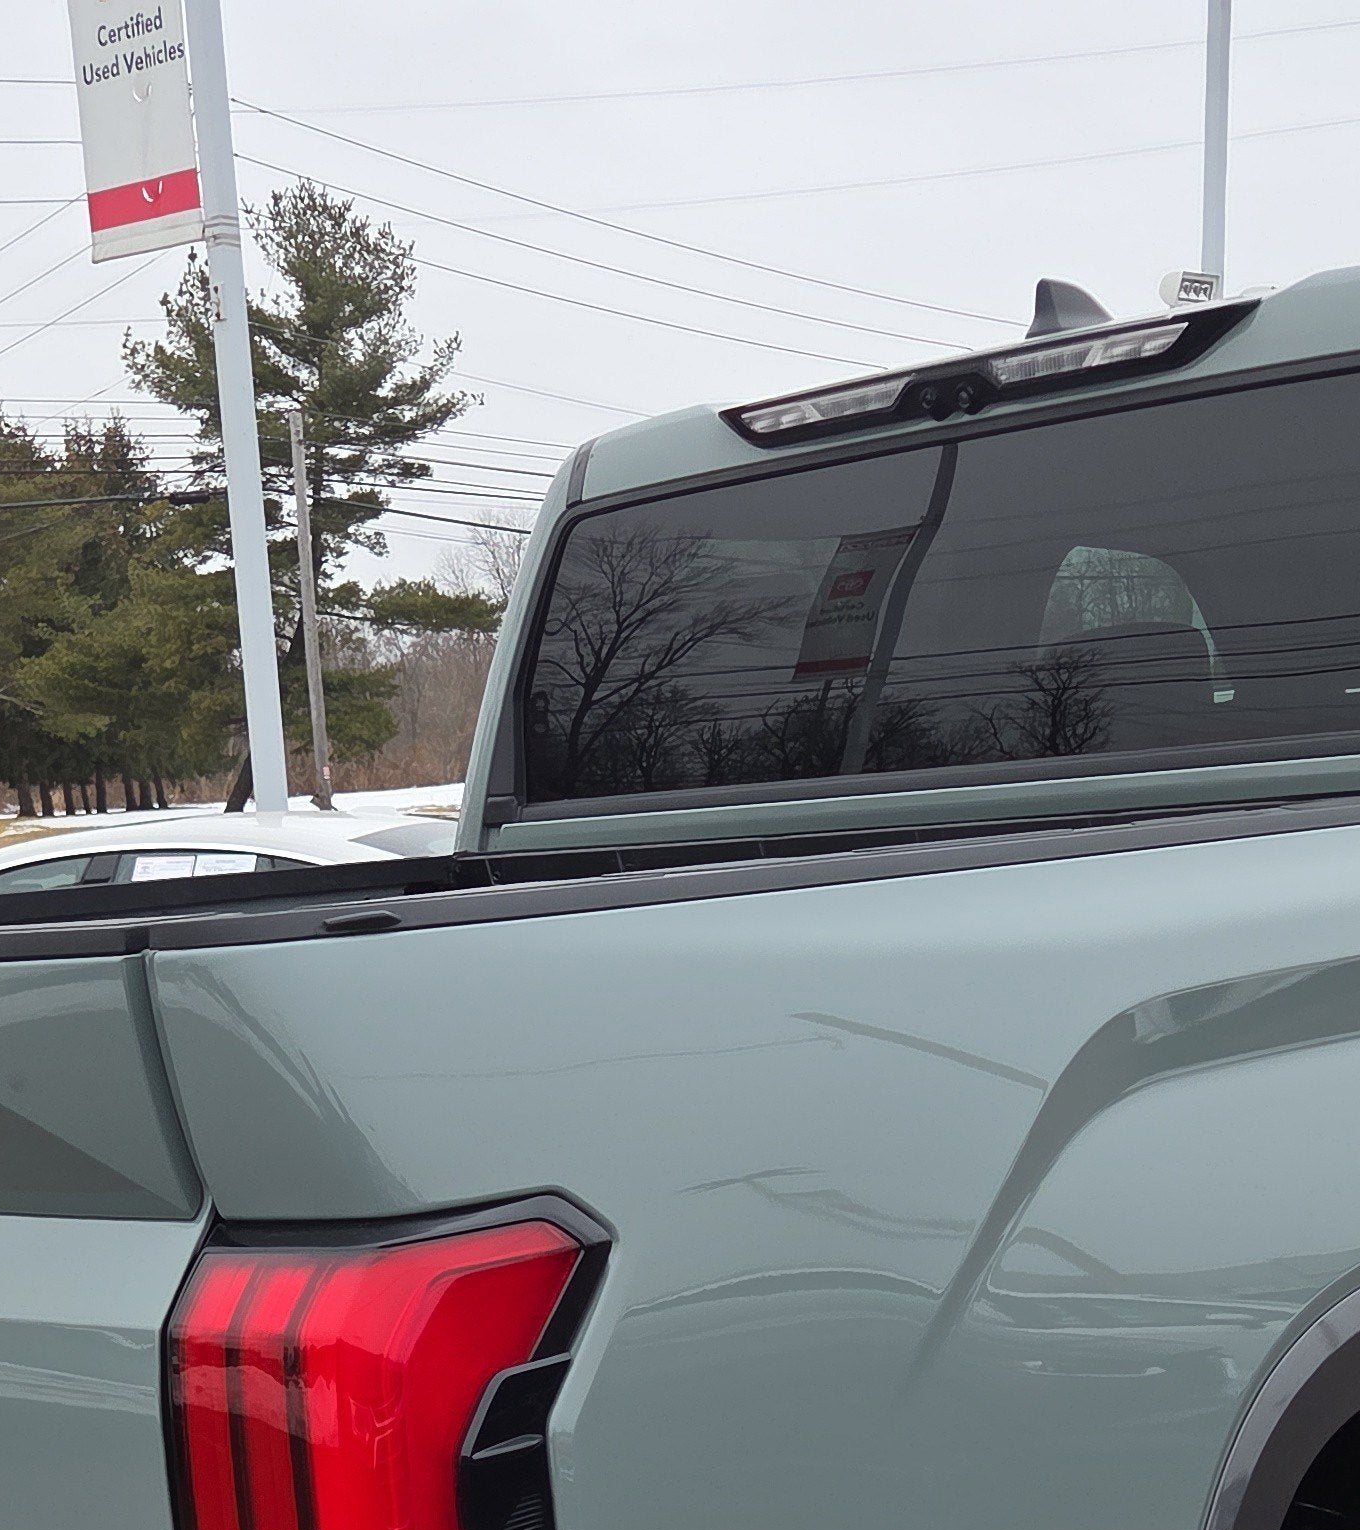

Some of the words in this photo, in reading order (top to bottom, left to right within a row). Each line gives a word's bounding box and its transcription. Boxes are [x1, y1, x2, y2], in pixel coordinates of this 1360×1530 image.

[97, 6, 163, 48] Certified
[82, 54, 120, 86] Used
[123, 40, 186, 74] Vehicles
